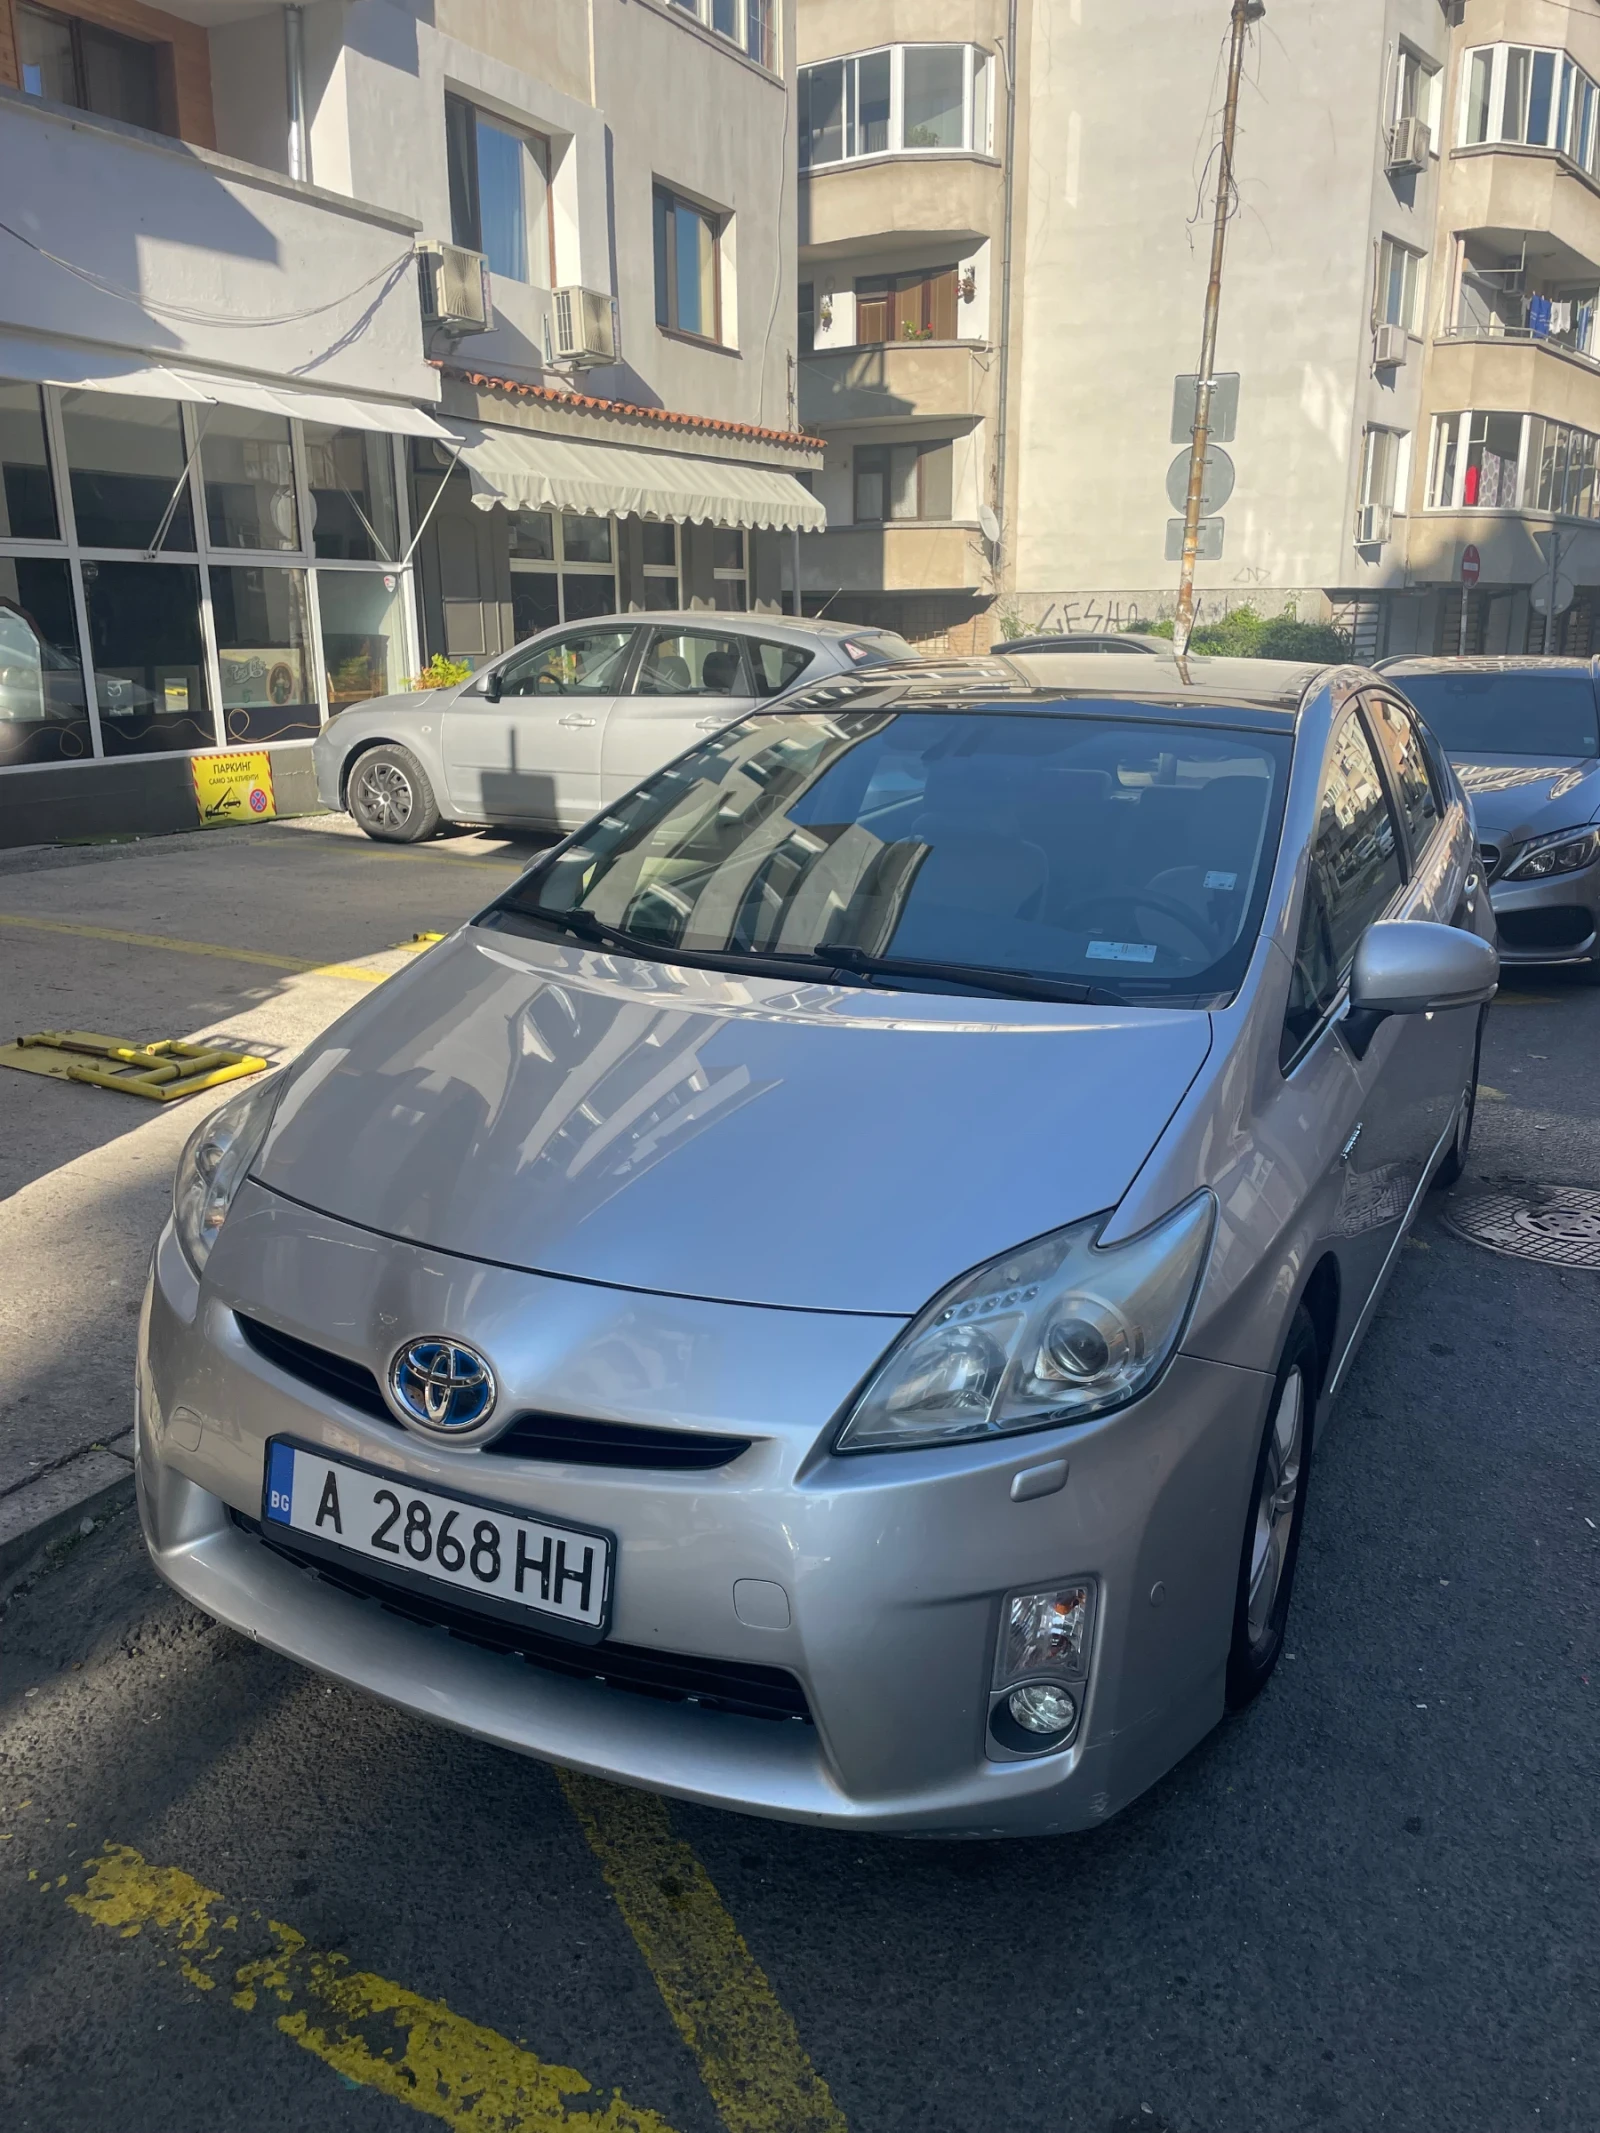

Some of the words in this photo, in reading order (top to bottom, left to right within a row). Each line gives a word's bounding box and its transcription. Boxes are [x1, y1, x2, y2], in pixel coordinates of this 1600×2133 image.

[213, 761, 251, 774] ПАРКИНГ
[235, 774, 259, 782] КЛИЕНТИ
[270, 1490, 290, 1512] BG
[315, 1470, 343, 1534] A
[371, 1488, 501, 1583] 2868
[514, 1529, 594, 1612] HH
